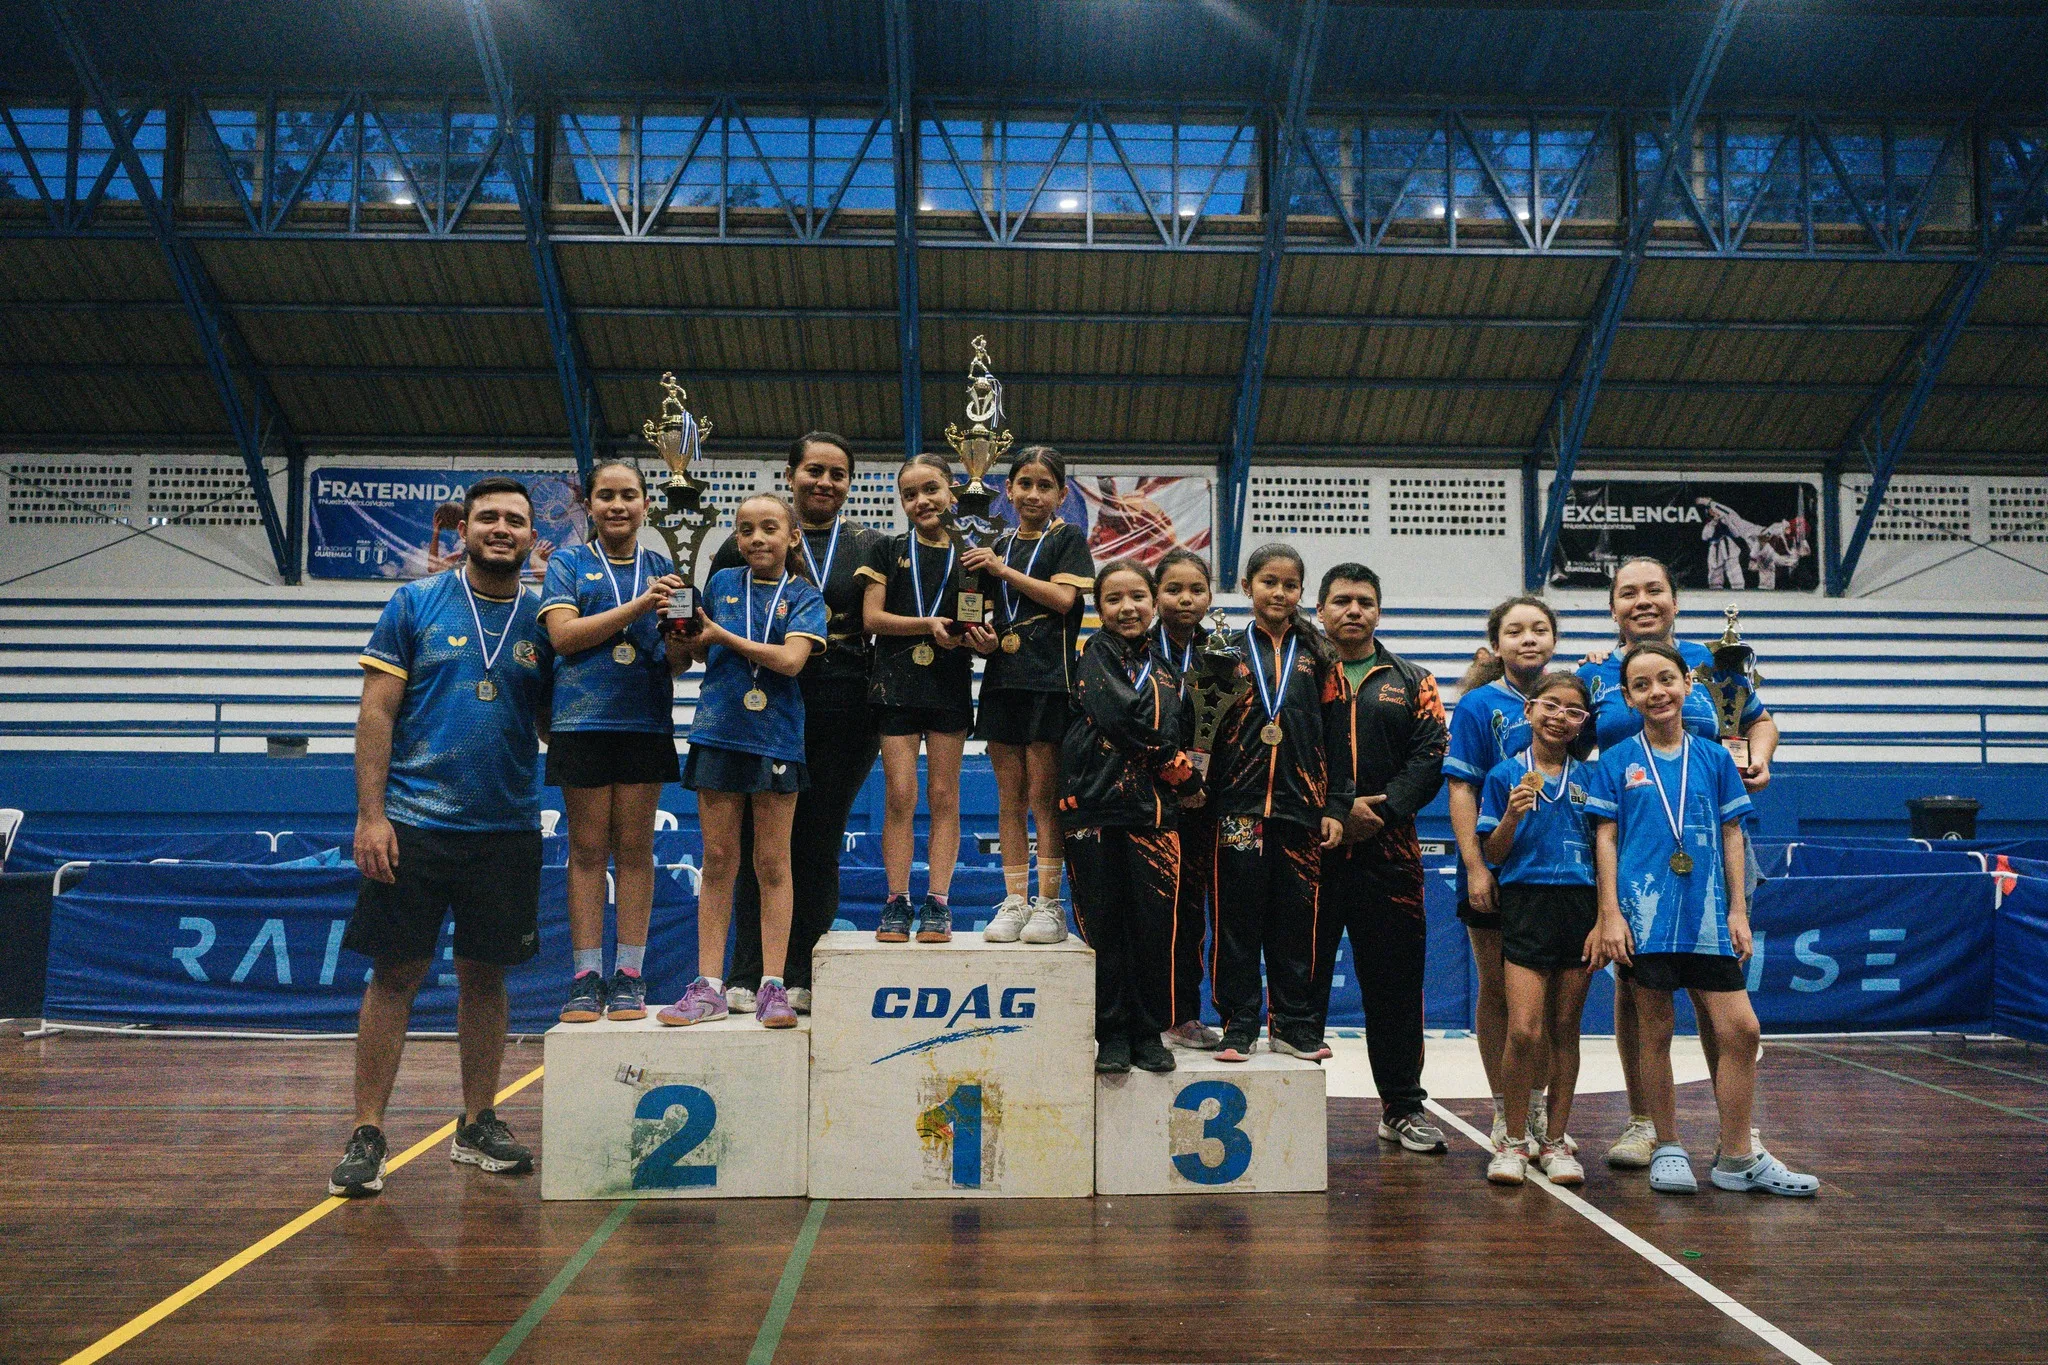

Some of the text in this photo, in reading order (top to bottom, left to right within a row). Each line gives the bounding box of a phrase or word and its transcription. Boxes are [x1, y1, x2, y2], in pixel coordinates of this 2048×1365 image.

[317, 480, 467, 501] FRATERNIDA
[1562, 505, 1702, 523] EXCELENCIA
[1381, 683, 1406, 695] Coach
[172, 917, 460, 987] RAI
[1745, 927, 1908, 993] ISE
[870, 983, 1037, 1029] CDAG
[631, 1084, 718, 1191] 2
[922, 1083, 983, 1190] 1
[1171, 1080, 1254, 1186] 3
